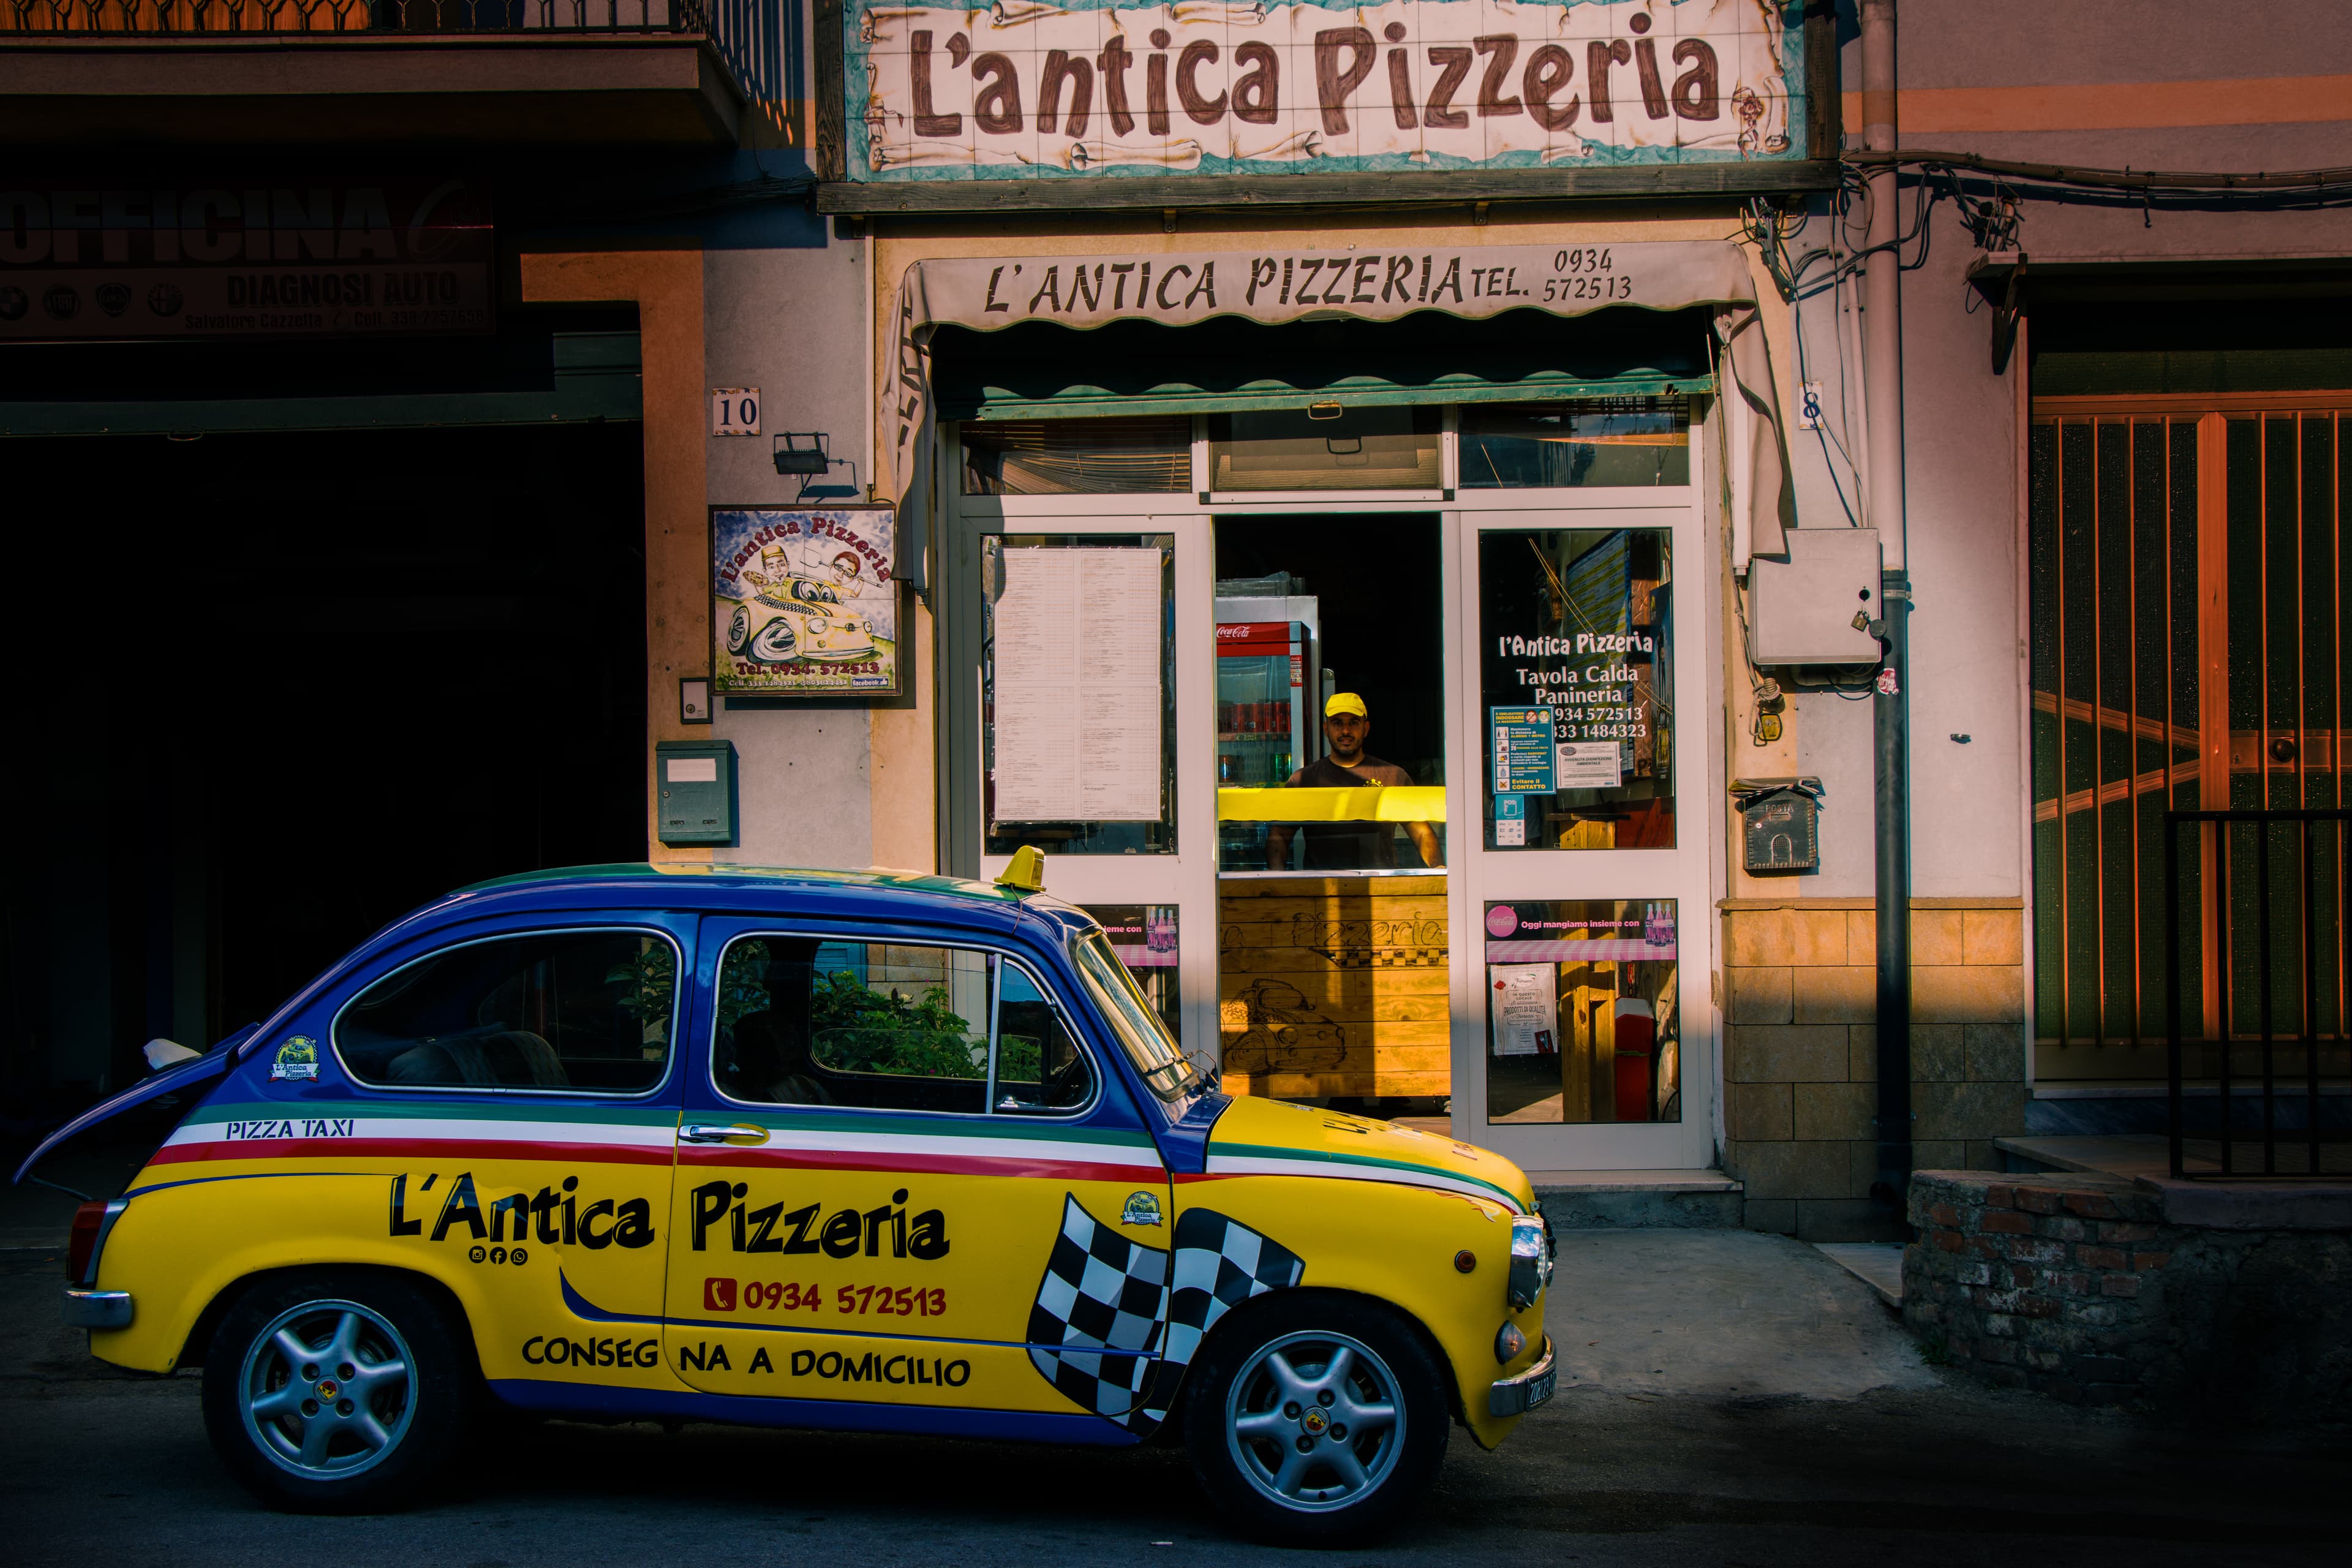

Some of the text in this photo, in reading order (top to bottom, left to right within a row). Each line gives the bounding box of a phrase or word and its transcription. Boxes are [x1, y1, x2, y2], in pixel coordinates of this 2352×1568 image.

[910, 12, 1721, 137] L'antica Pizzeria
[0, 187, 399, 264] OFFICINA
[1554, 249, 1613, 274] 0934
[227, 271, 460, 309] DIAGNOSI AUTO
[1245, 254, 1464, 306] PIZZERIA
[1471, 266, 1530, 298] TEL.
[1543, 276, 1633, 303] 572513
[185, 312, 255, 329] Salvatore
[720, 398, 756, 425] 10
[1803, 392, 1820, 418] 8
[720, 517, 891, 582] L'antica Pizzeria
[1499, 631, 1653, 657] l'Antica Pizzeria
[736, 662, 767, 675] Tel.
[820, 661, 880, 675] 572513
[1516, 663, 1638, 685] Tavola Calda
[1535, 685, 1623, 704] Panineria
[1586, 707, 1643, 720] 572513
[1581, 725, 1646, 737] 1484323
[1766, 803, 1794, 813] POSTA
[1292, 911, 1446, 946] Pizzeria
[1521, 921, 1542, 929] Oggi
[1543, 921, 1588, 929] mangiamo
[1504, 1006, 1523, 1017] PRODOTTI
[226, 1119, 354, 1139] PIZZA TAXI
[390, 1172, 950, 1260] L'Antica Pizzeria
[744, 1281, 946, 1316] 0934 572513
[522, 1336, 971, 1387] CONSEG NA A DOMICILIO
